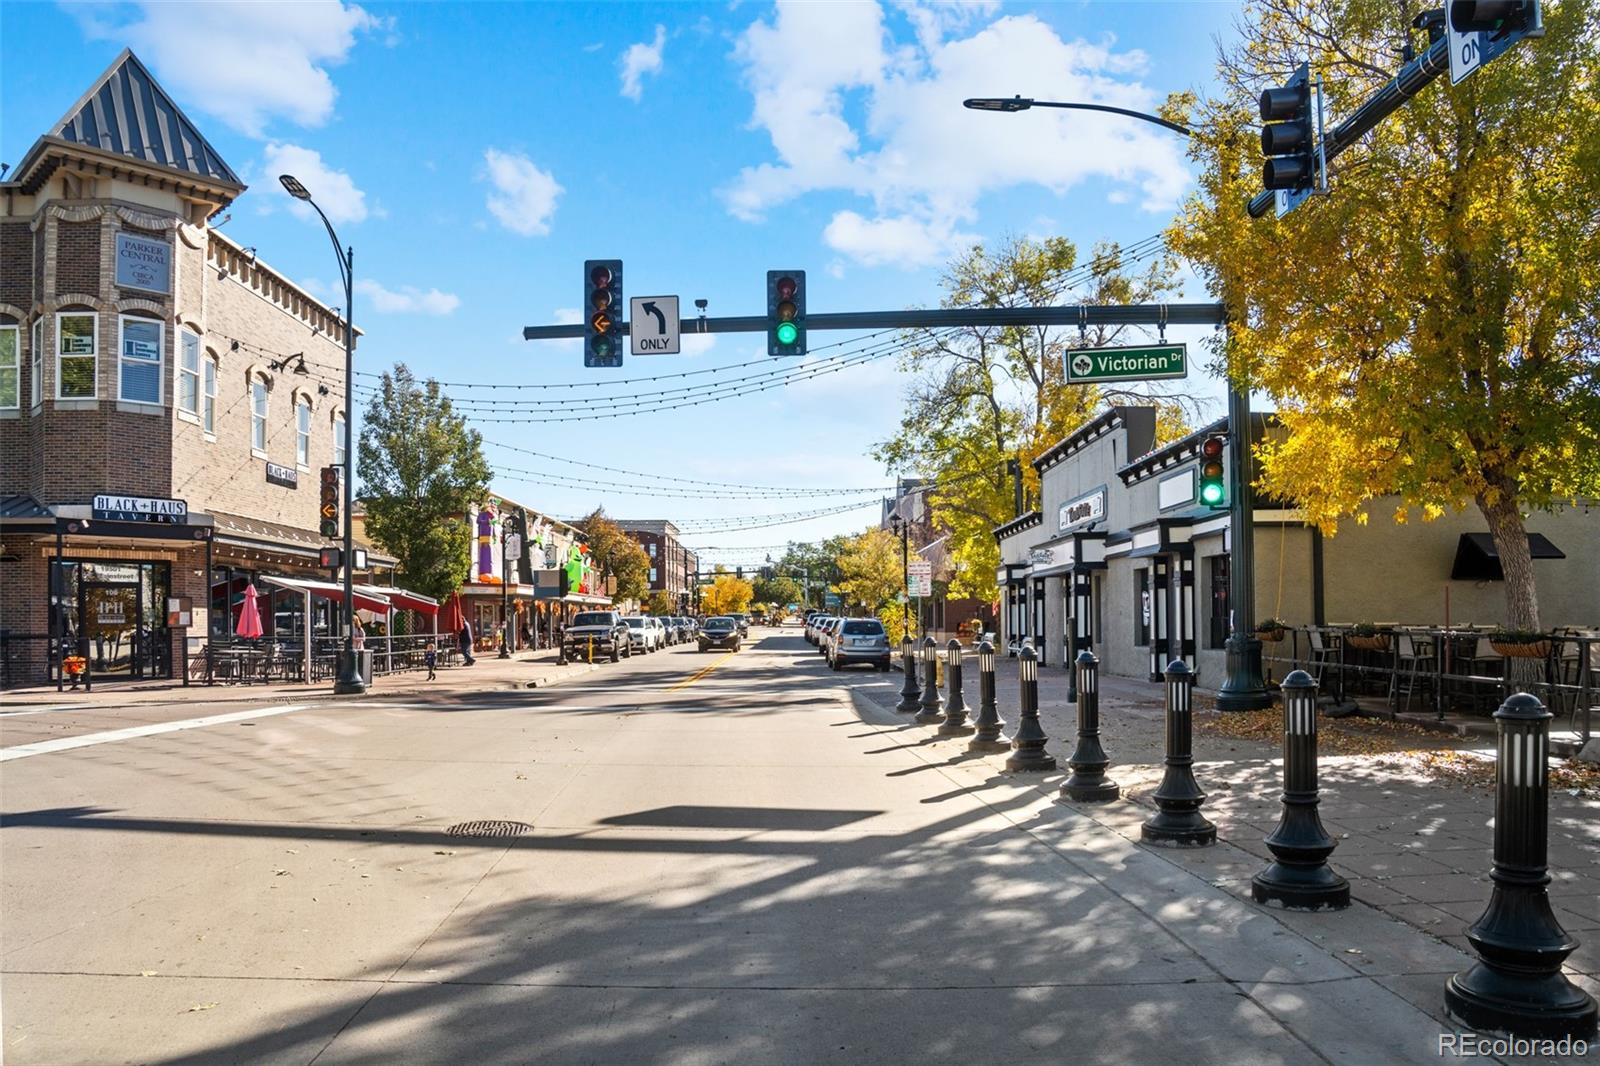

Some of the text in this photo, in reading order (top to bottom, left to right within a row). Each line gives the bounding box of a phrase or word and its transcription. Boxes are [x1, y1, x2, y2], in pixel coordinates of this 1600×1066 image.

[1462, 38, 1480, 65] ON
[124, 241, 164, 255] PARKER
[121, 249, 166, 265] CENTRAL
[640, 338, 670, 350] ONLY
[1097, 352, 1182, 372] Victorian Dr
[97, 497, 139, 512] BLACK
[150, 501, 184, 514] HAUS
[103, 511, 178, 523] TAVERN
